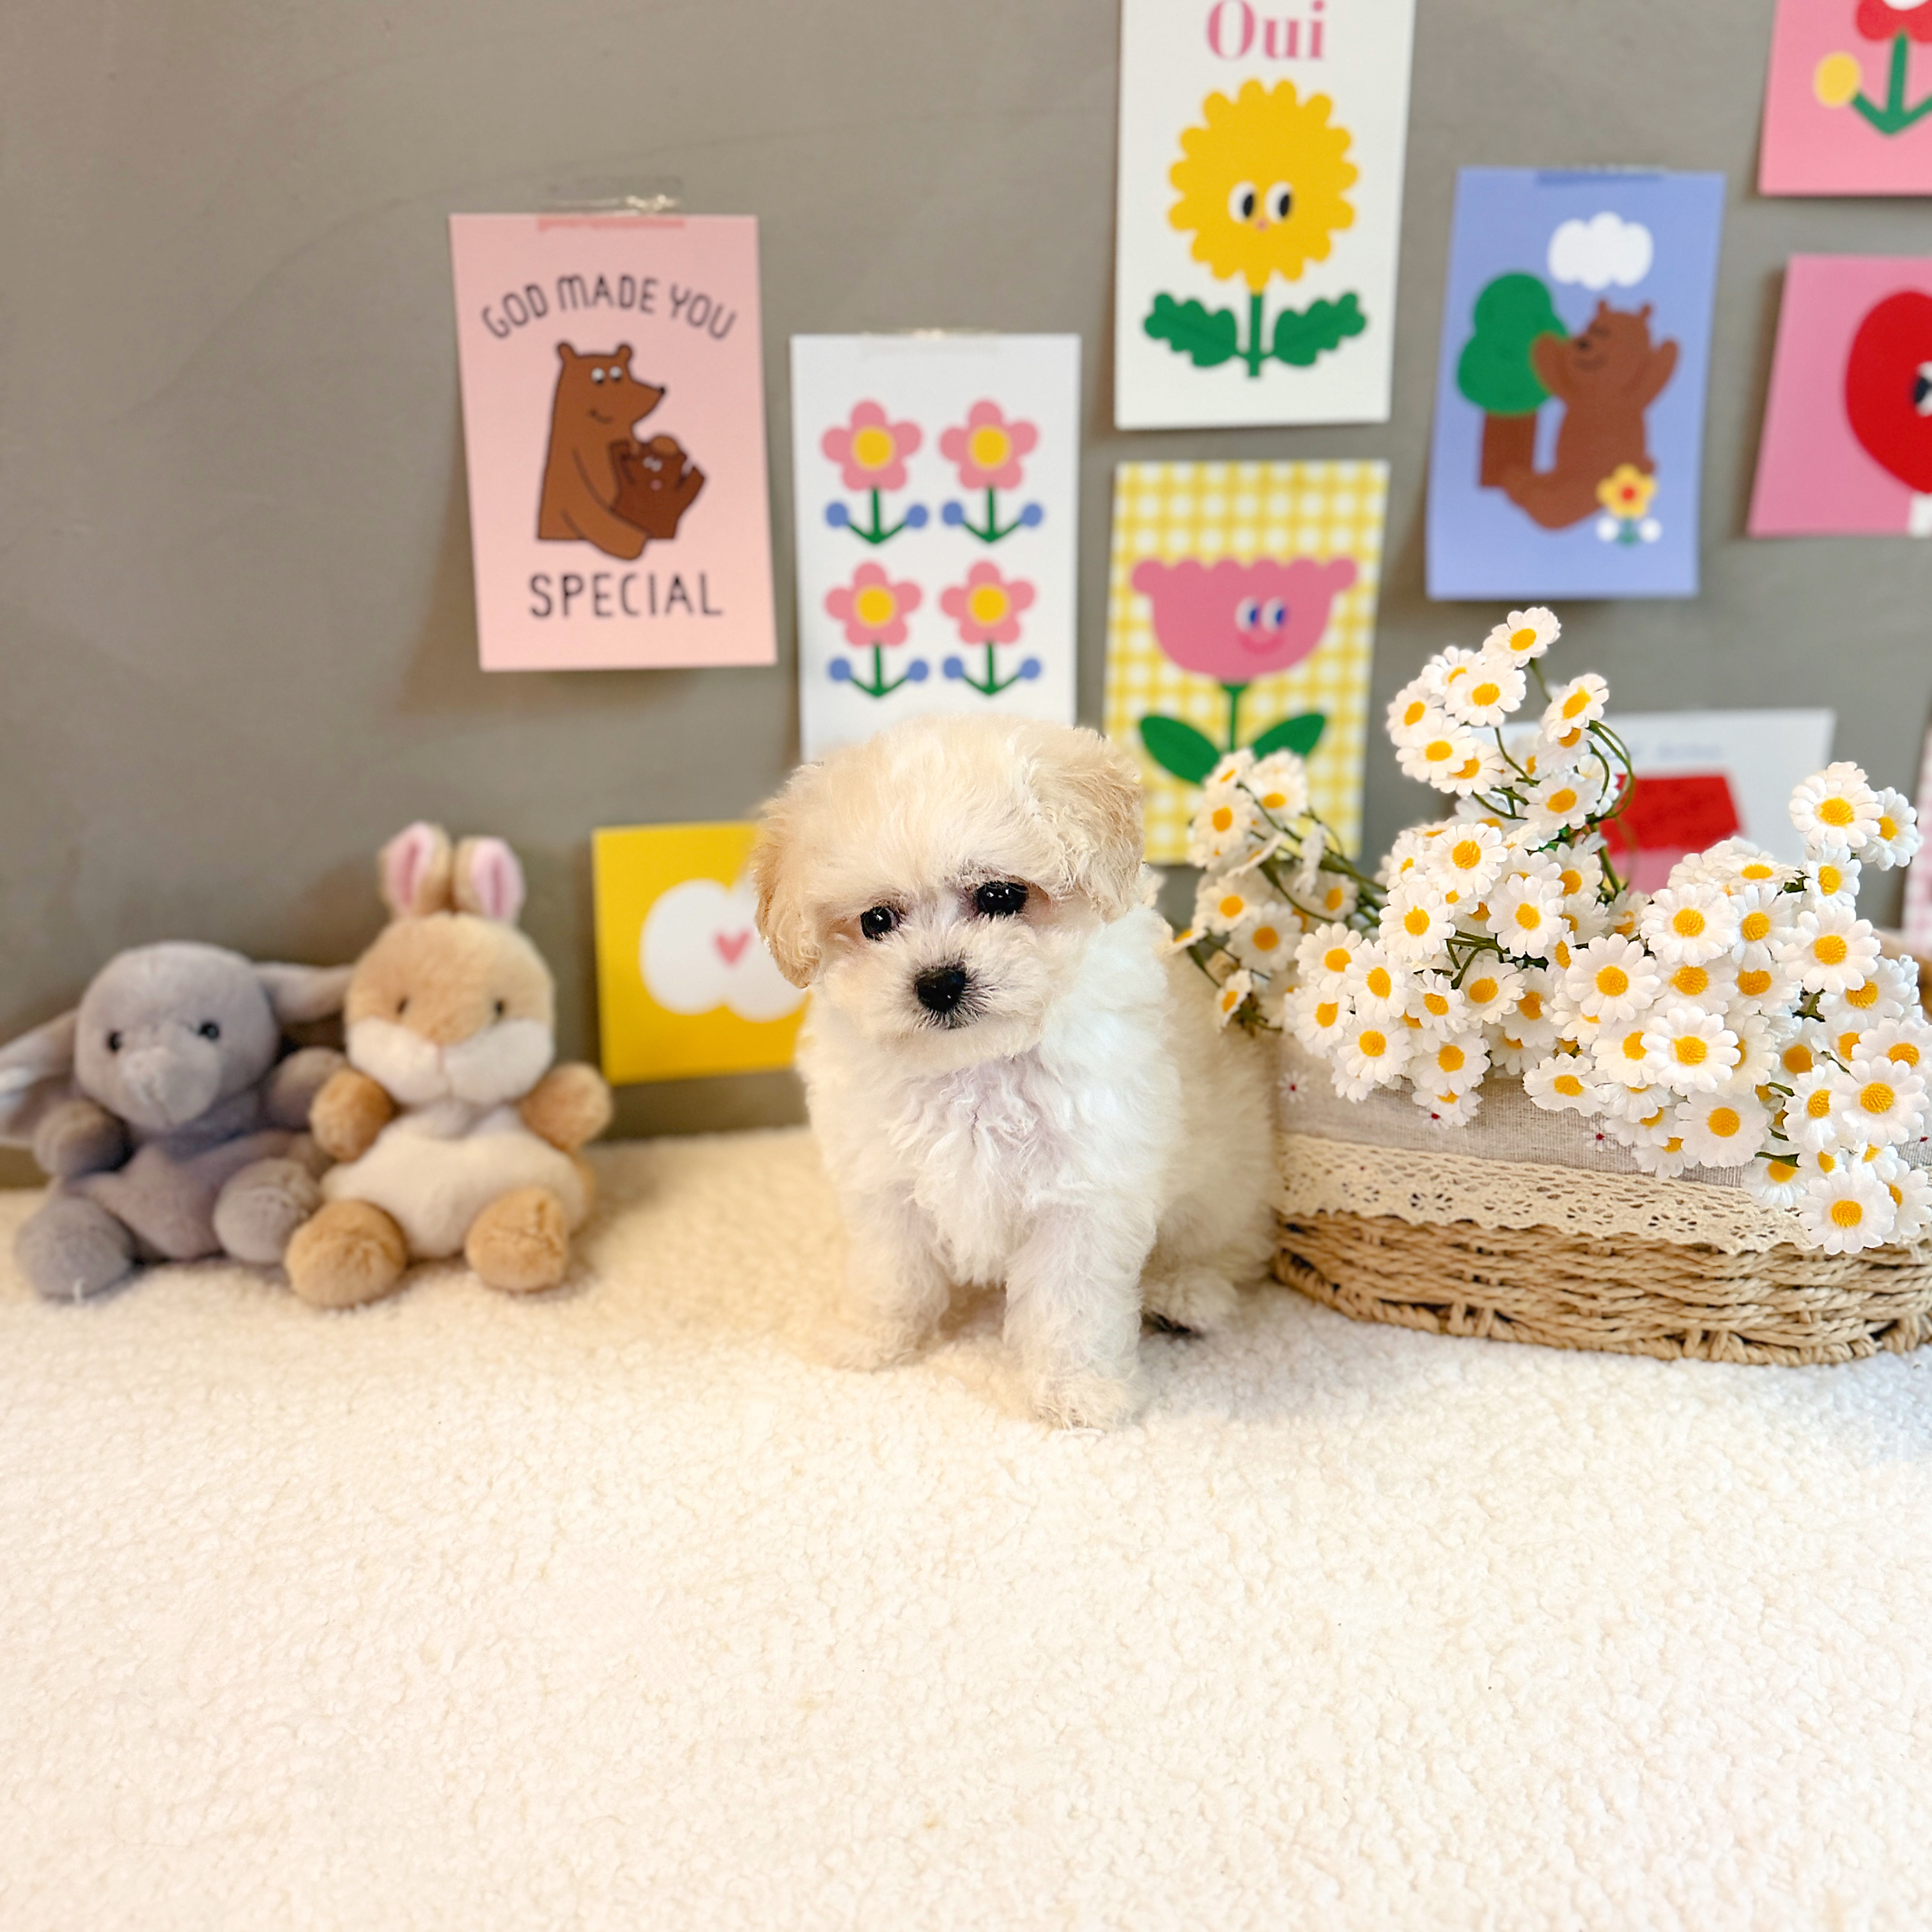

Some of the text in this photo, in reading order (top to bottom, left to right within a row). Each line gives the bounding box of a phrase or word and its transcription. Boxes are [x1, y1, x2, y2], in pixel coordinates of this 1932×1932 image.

[1207, 0, 1325, 59] Oui
[481, 274, 738, 339] GOD MADE YOU
[530, 573, 723, 617] SPECIAL
